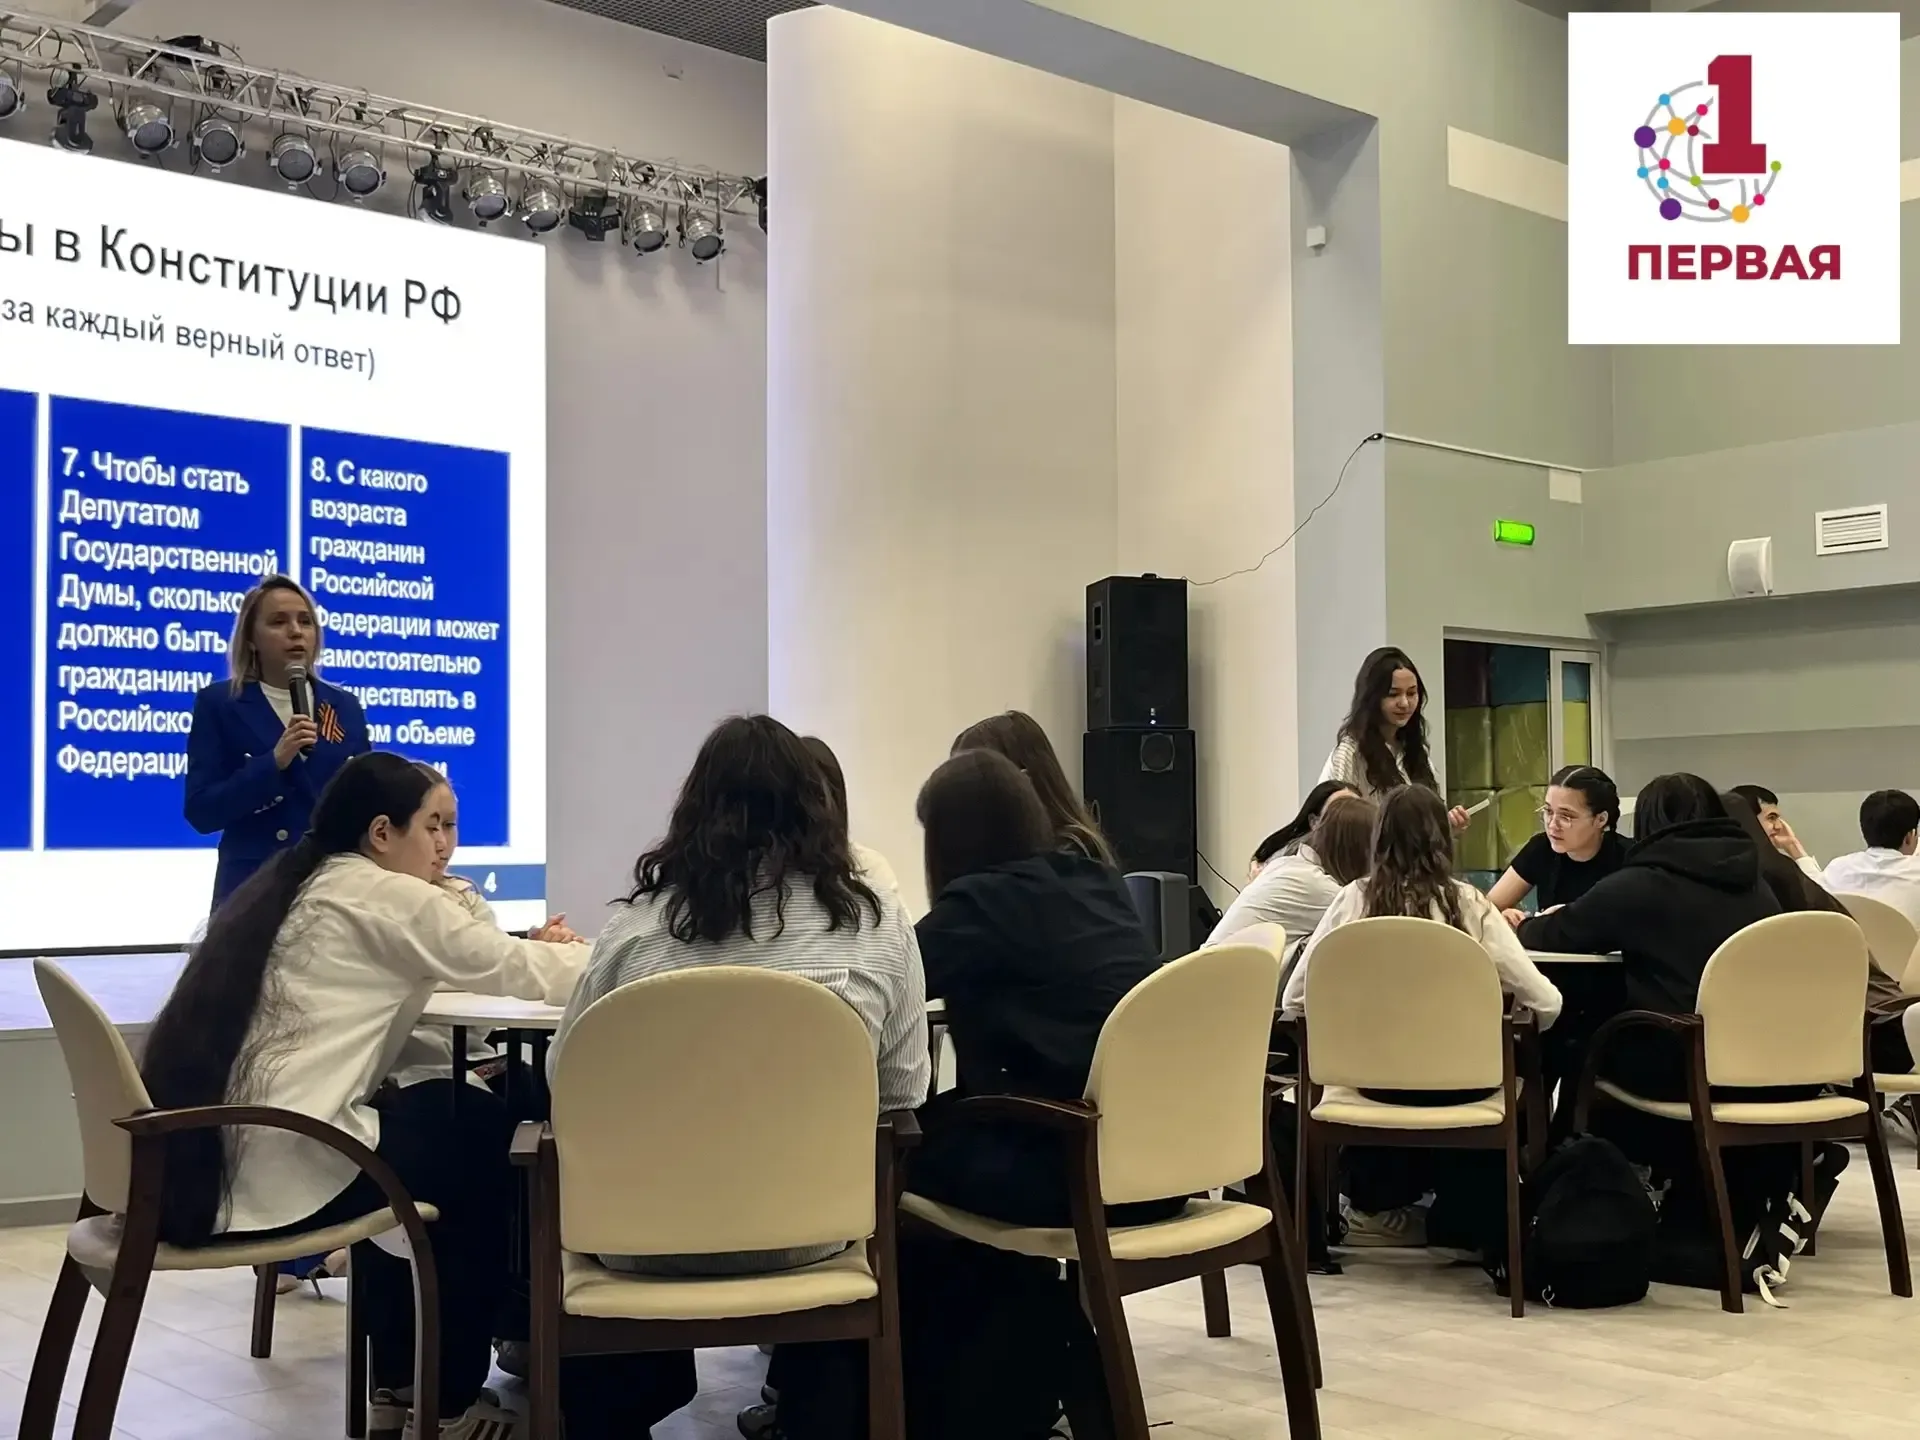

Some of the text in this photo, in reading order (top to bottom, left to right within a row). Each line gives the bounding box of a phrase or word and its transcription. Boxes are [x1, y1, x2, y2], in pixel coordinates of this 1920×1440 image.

[55, 229, 81, 262] в
[100, 225, 388, 315] Конституции
[404, 280, 462, 324] РФ
[2, 299, 376, 380] за каждый верный ответ)
[61, 447, 250, 495] 7. Чтобы стать
[310, 457, 428, 494] 8. С какого
[59, 489, 200, 530] Депутатом
[310, 500, 407, 527] возраста
[59, 532, 279, 576] Государственной
[310, 536, 425, 565] гражданин
[58, 573, 245, 614] Думы, сколько
[310, 567, 435, 601] Российской
[58, 622, 228, 653] должно быть
[436, 618, 500, 641] может
[59, 701, 193, 734] Российско
[463, 691, 476, 710] в
[396, 719, 476, 746] объеме
[57, 744, 189, 780] Федераци
[484, 871, 497, 893] 4
